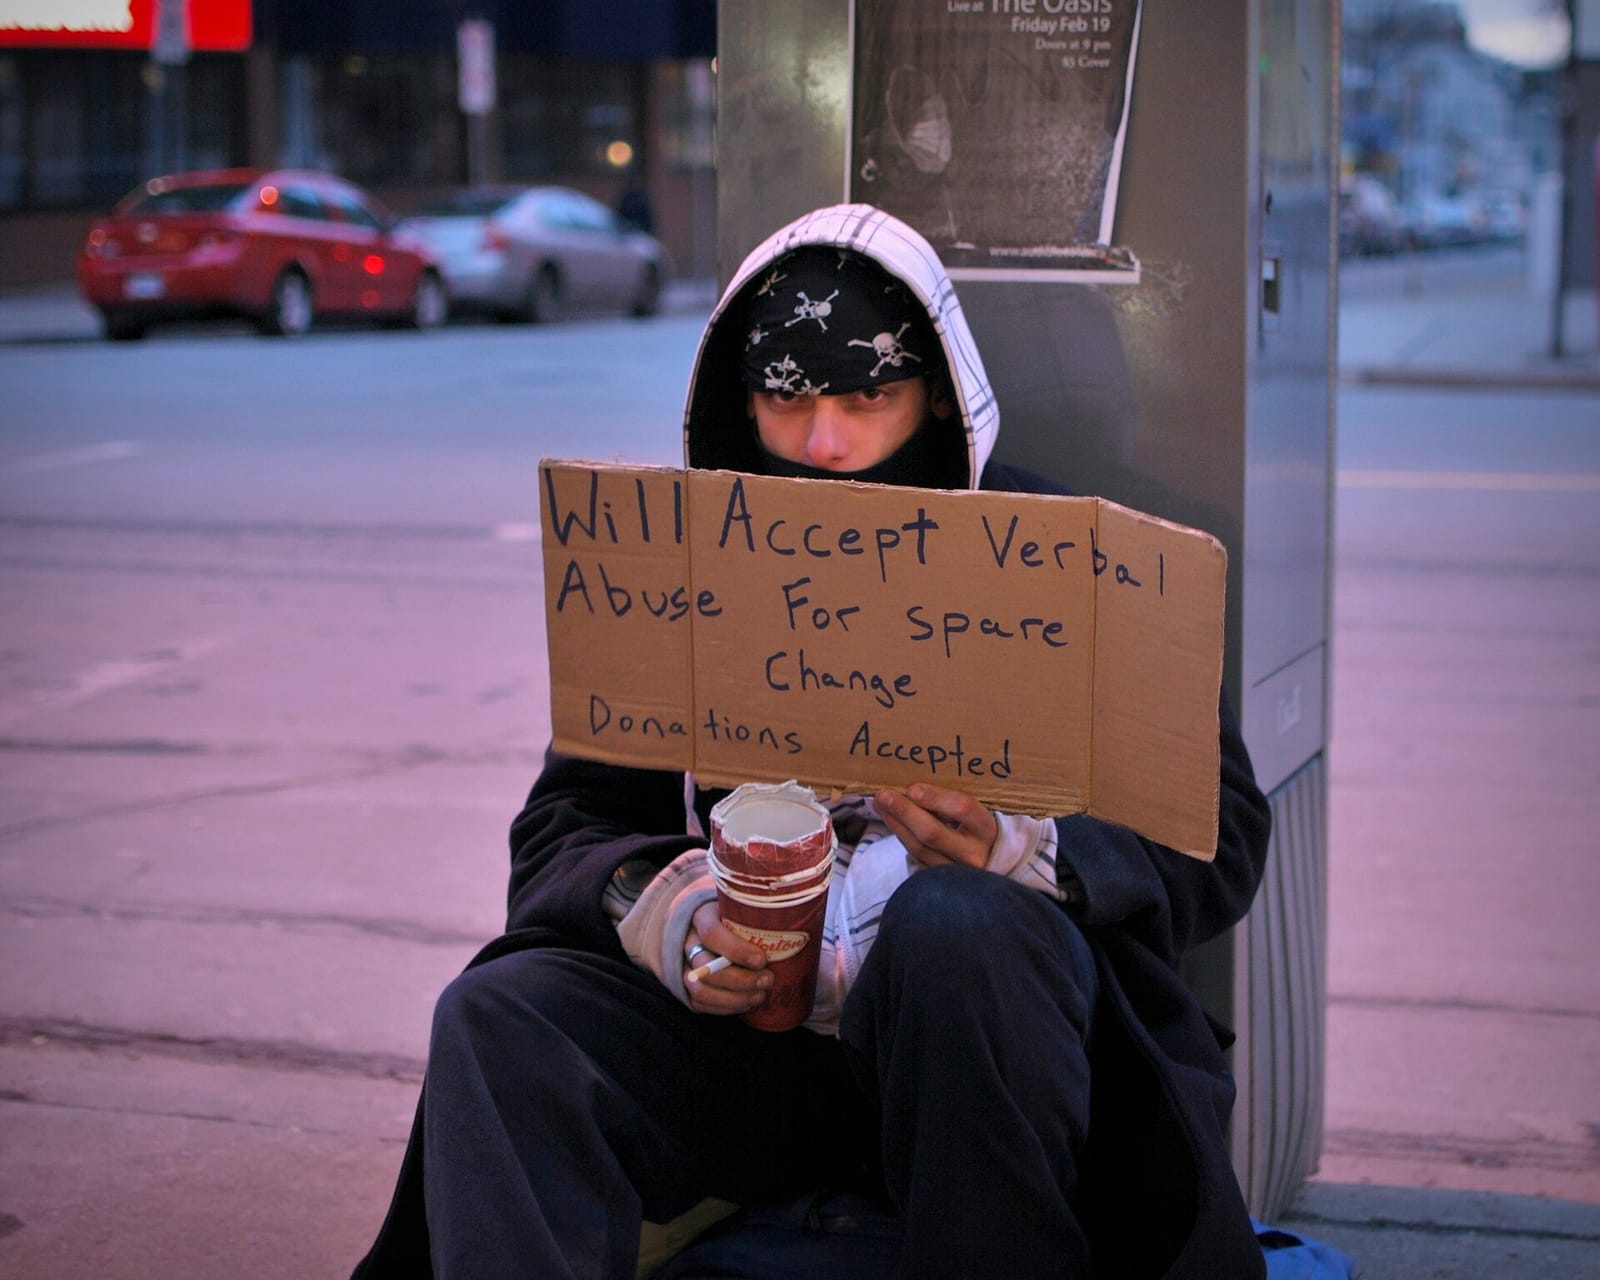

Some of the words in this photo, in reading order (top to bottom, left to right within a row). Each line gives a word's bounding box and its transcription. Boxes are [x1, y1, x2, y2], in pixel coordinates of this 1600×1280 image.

[1011, 17, 1057, 35] Friday
[1059, 17, 1088, 32] Feb
[1092, 18, 1111, 32] 19
[1043, 0, 1112, 13] Oasis
[1035, 38, 1067, 50] Doors
[1078, 56, 1110, 68] Cover
[543, 467, 683, 547] Will
[718, 477, 939, 583] Accept
[982, 514, 1166, 597] Verbal
[556, 559, 723, 622] Abuse
[782, 577, 860, 631] For
[765, 649, 917, 709] Change
[589, 694, 803, 754] Donations
[849, 721, 1012, 779] Accepted
